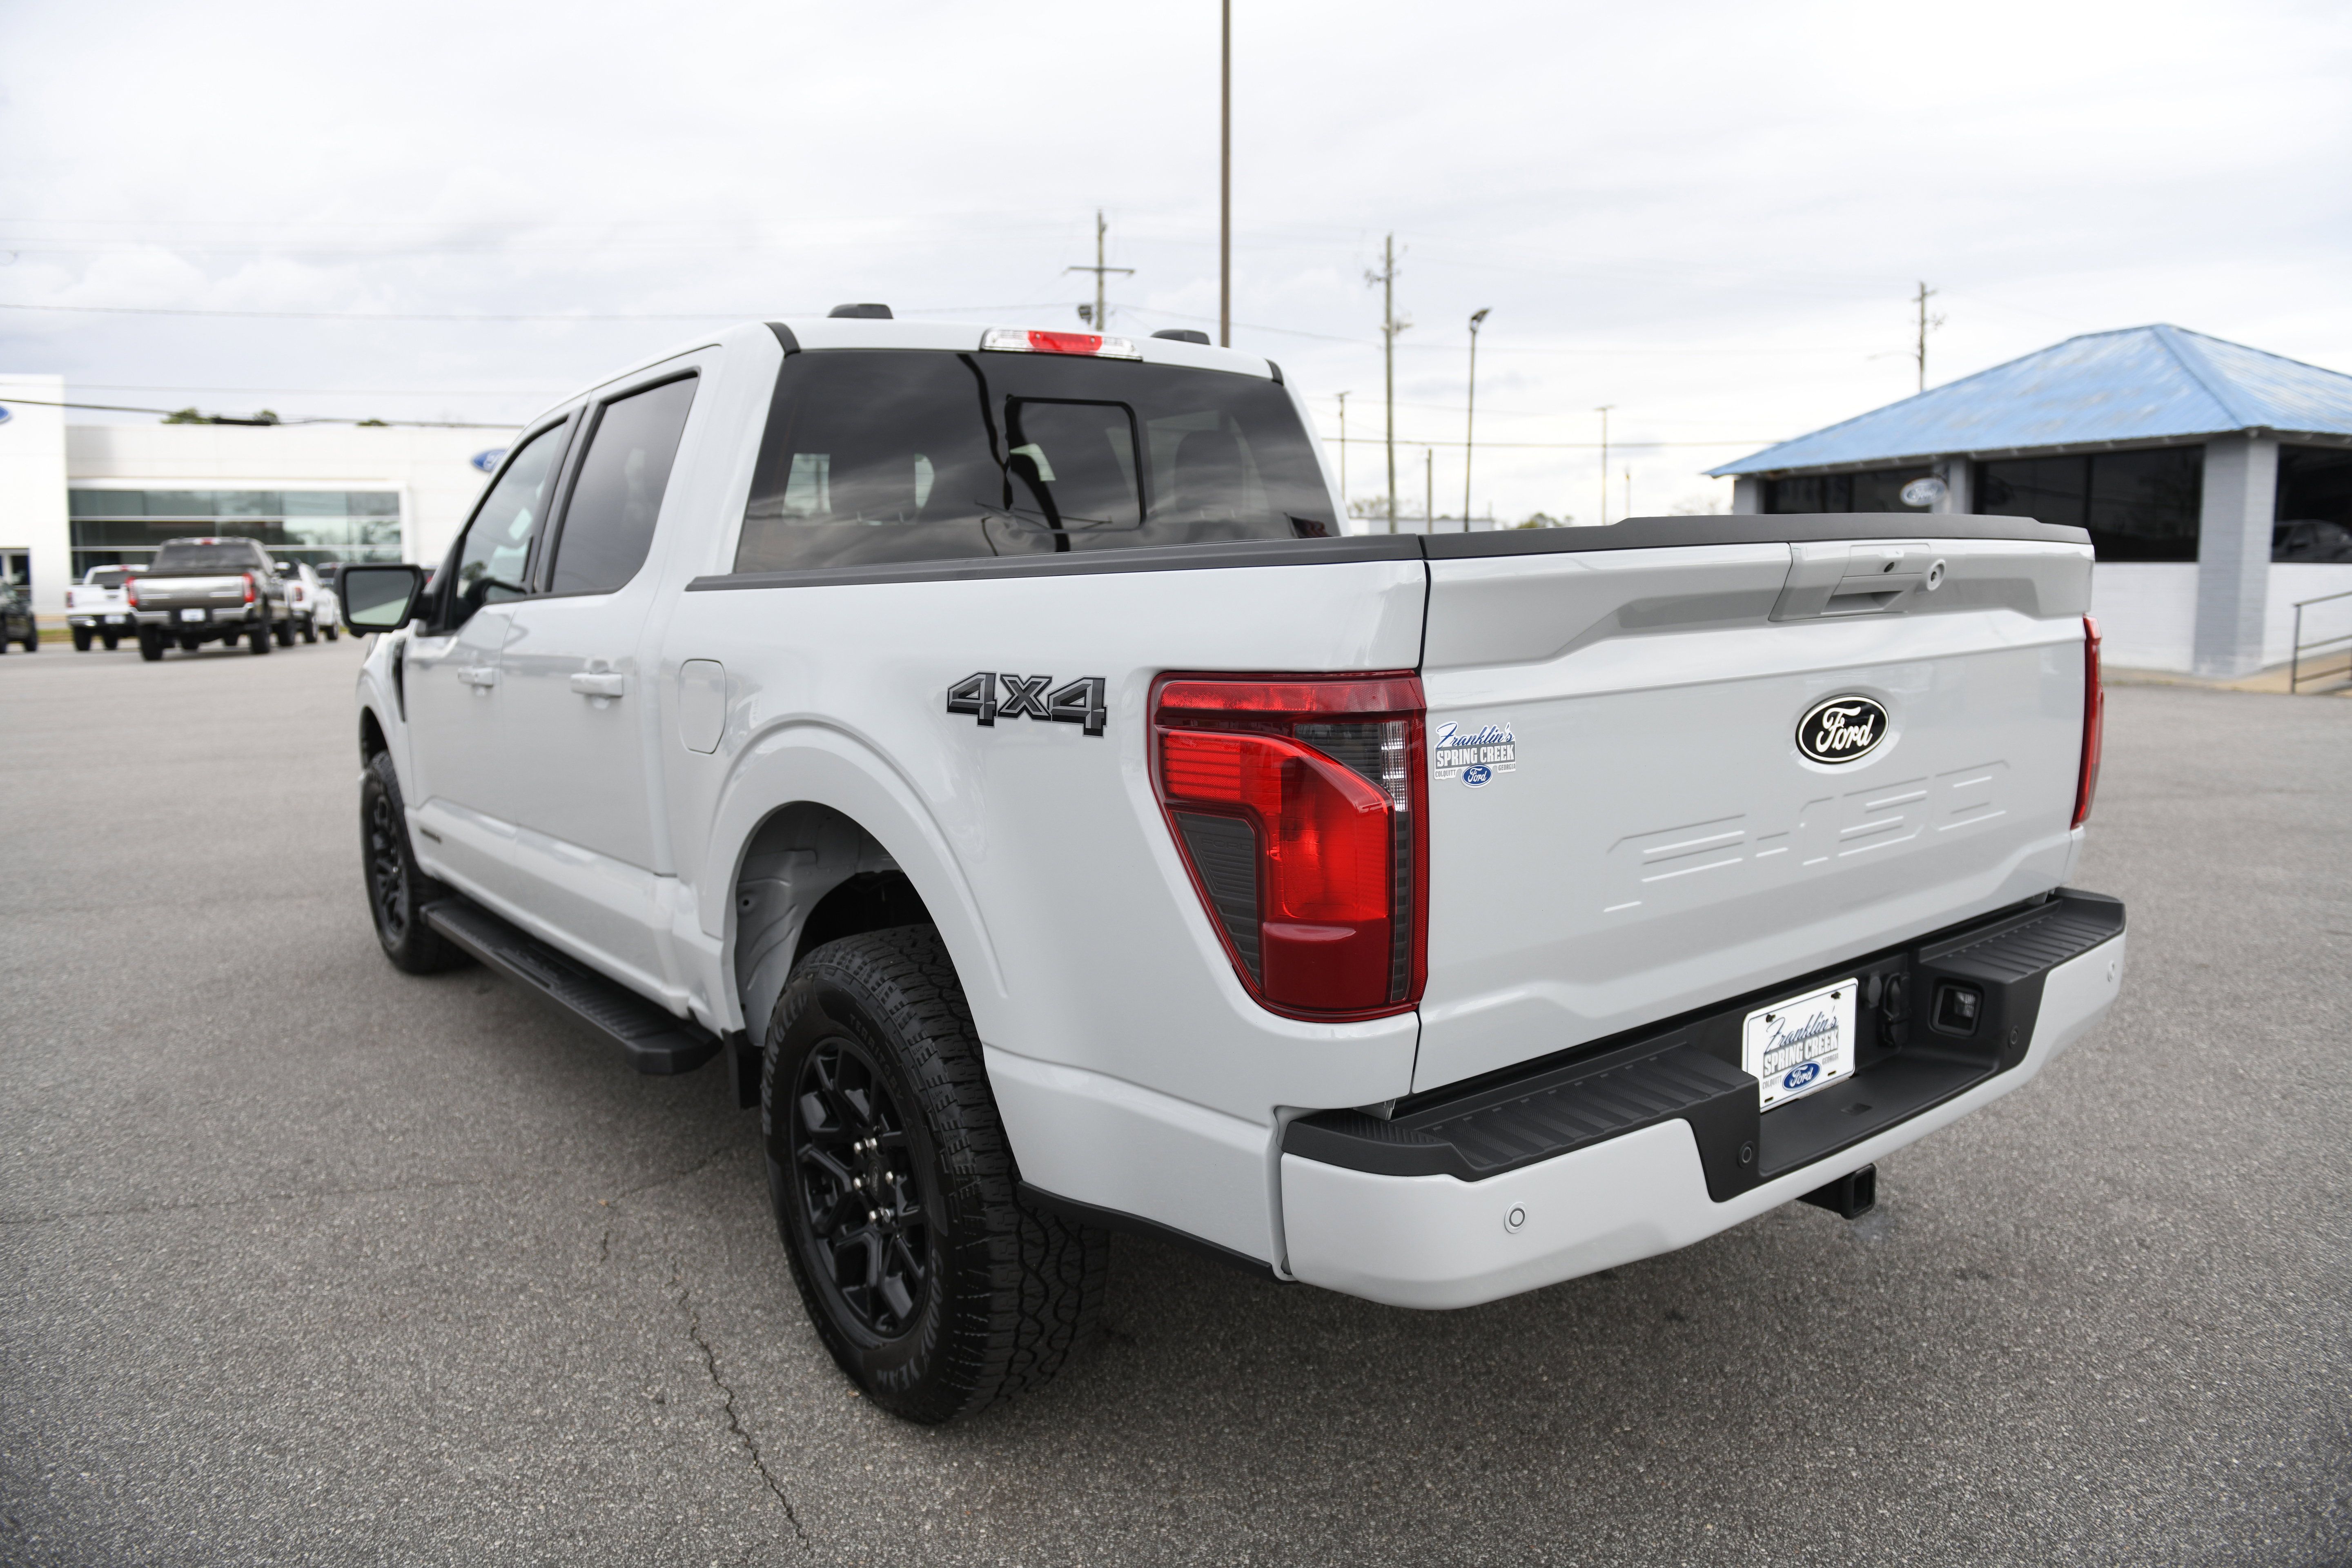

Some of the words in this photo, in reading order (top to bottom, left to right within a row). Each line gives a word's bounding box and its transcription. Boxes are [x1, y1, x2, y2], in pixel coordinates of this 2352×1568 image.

[947, 670, 1108, 738] 4X4
[1436, 722, 1514, 750] Franklin's
[1815, 706, 1875, 753] Ford
[1437, 747, 1478, 767] SPRING
[1479, 744, 1515, 763] CREEK
[1435, 769, 1456, 777] COLQUITT
[1468, 767, 1487, 783] Ford
[1498, 763, 1516, 771] GEORGIA
[1201, 837, 1253, 853] FORD
[1764, 1005, 1839, 1054] Franklin's
[849, 1013, 904, 1100] TERRITORY
[1764, 1042, 1804, 1077] SPRING
[1804, 1030, 1838, 1060] CREEK
[1822, 1053, 1839, 1065] GEORGIA
[1762, 1075, 1782, 1089] COLQUITT
[1789, 1065, 1813, 1087] Ford
